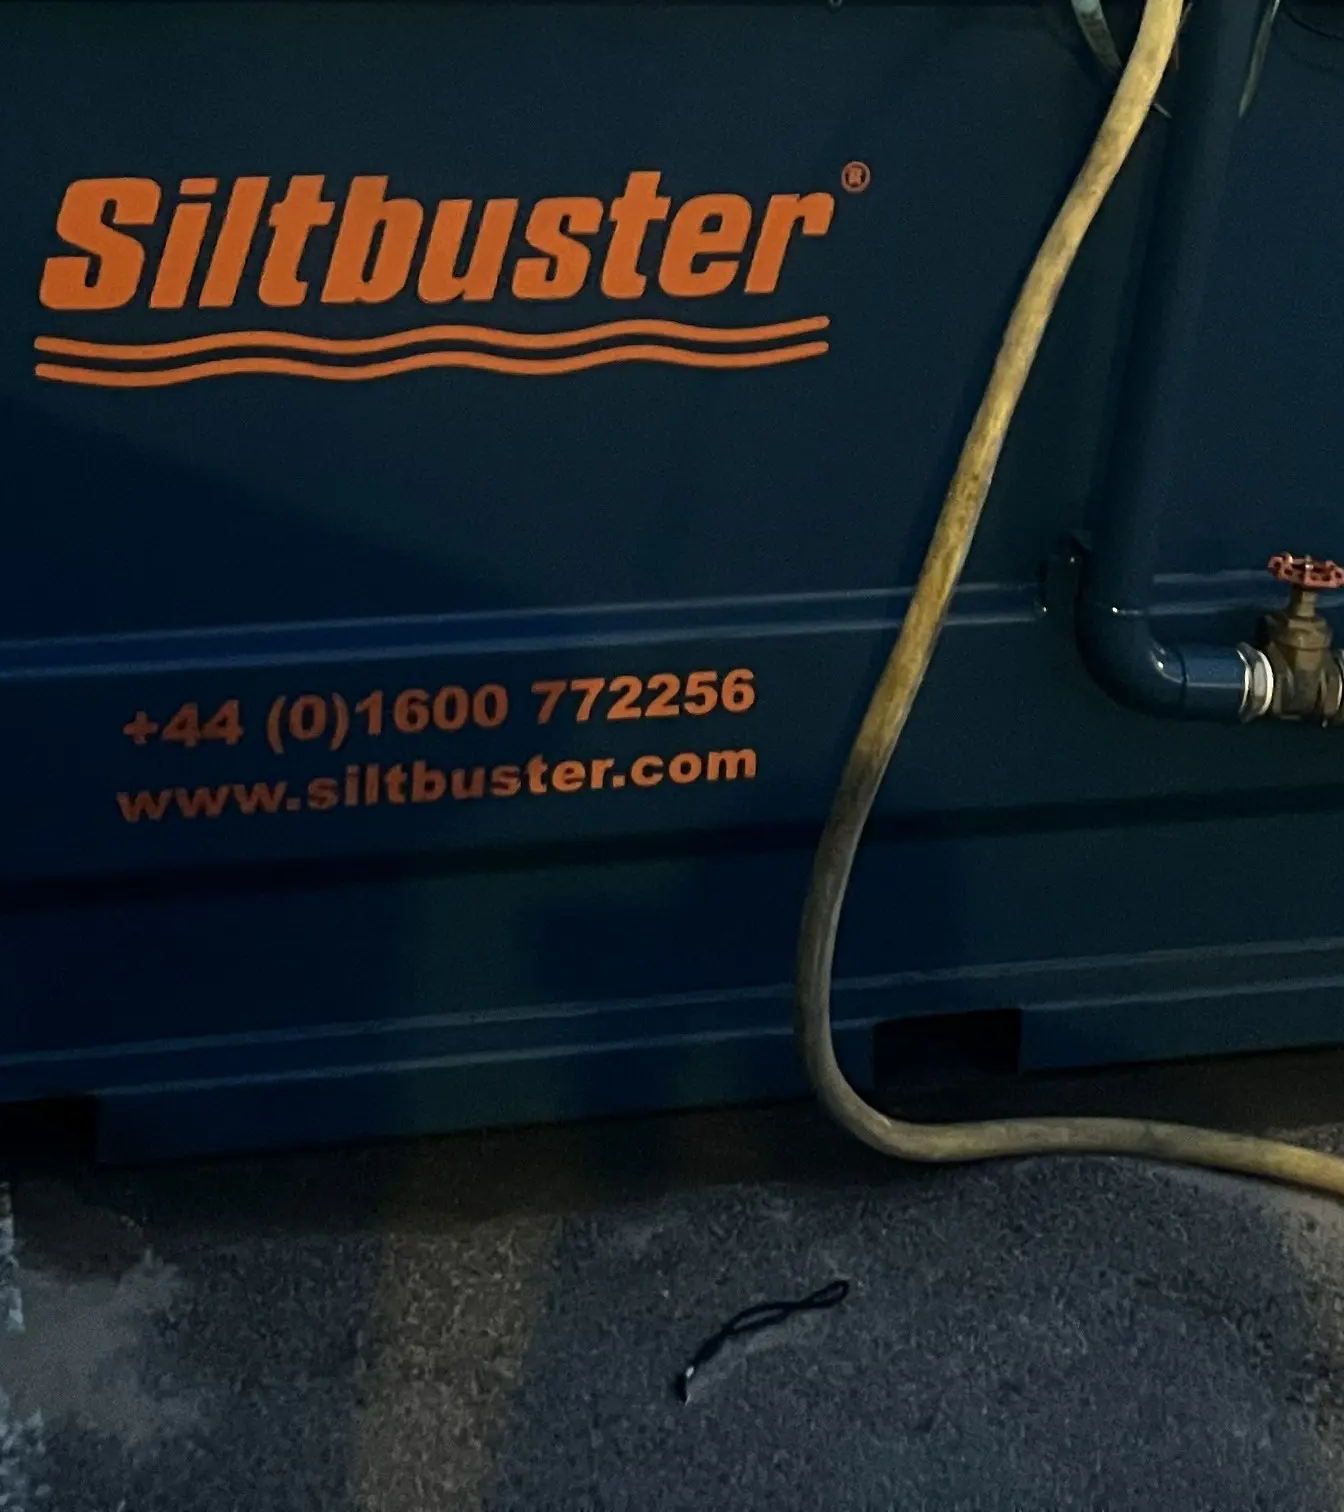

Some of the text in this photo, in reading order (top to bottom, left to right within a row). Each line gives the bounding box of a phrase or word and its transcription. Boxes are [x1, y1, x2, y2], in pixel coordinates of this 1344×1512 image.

[123, 667, 756, 754] +44 (0)1600 772256
[115, 746, 757, 822] www.siltbuster.com
